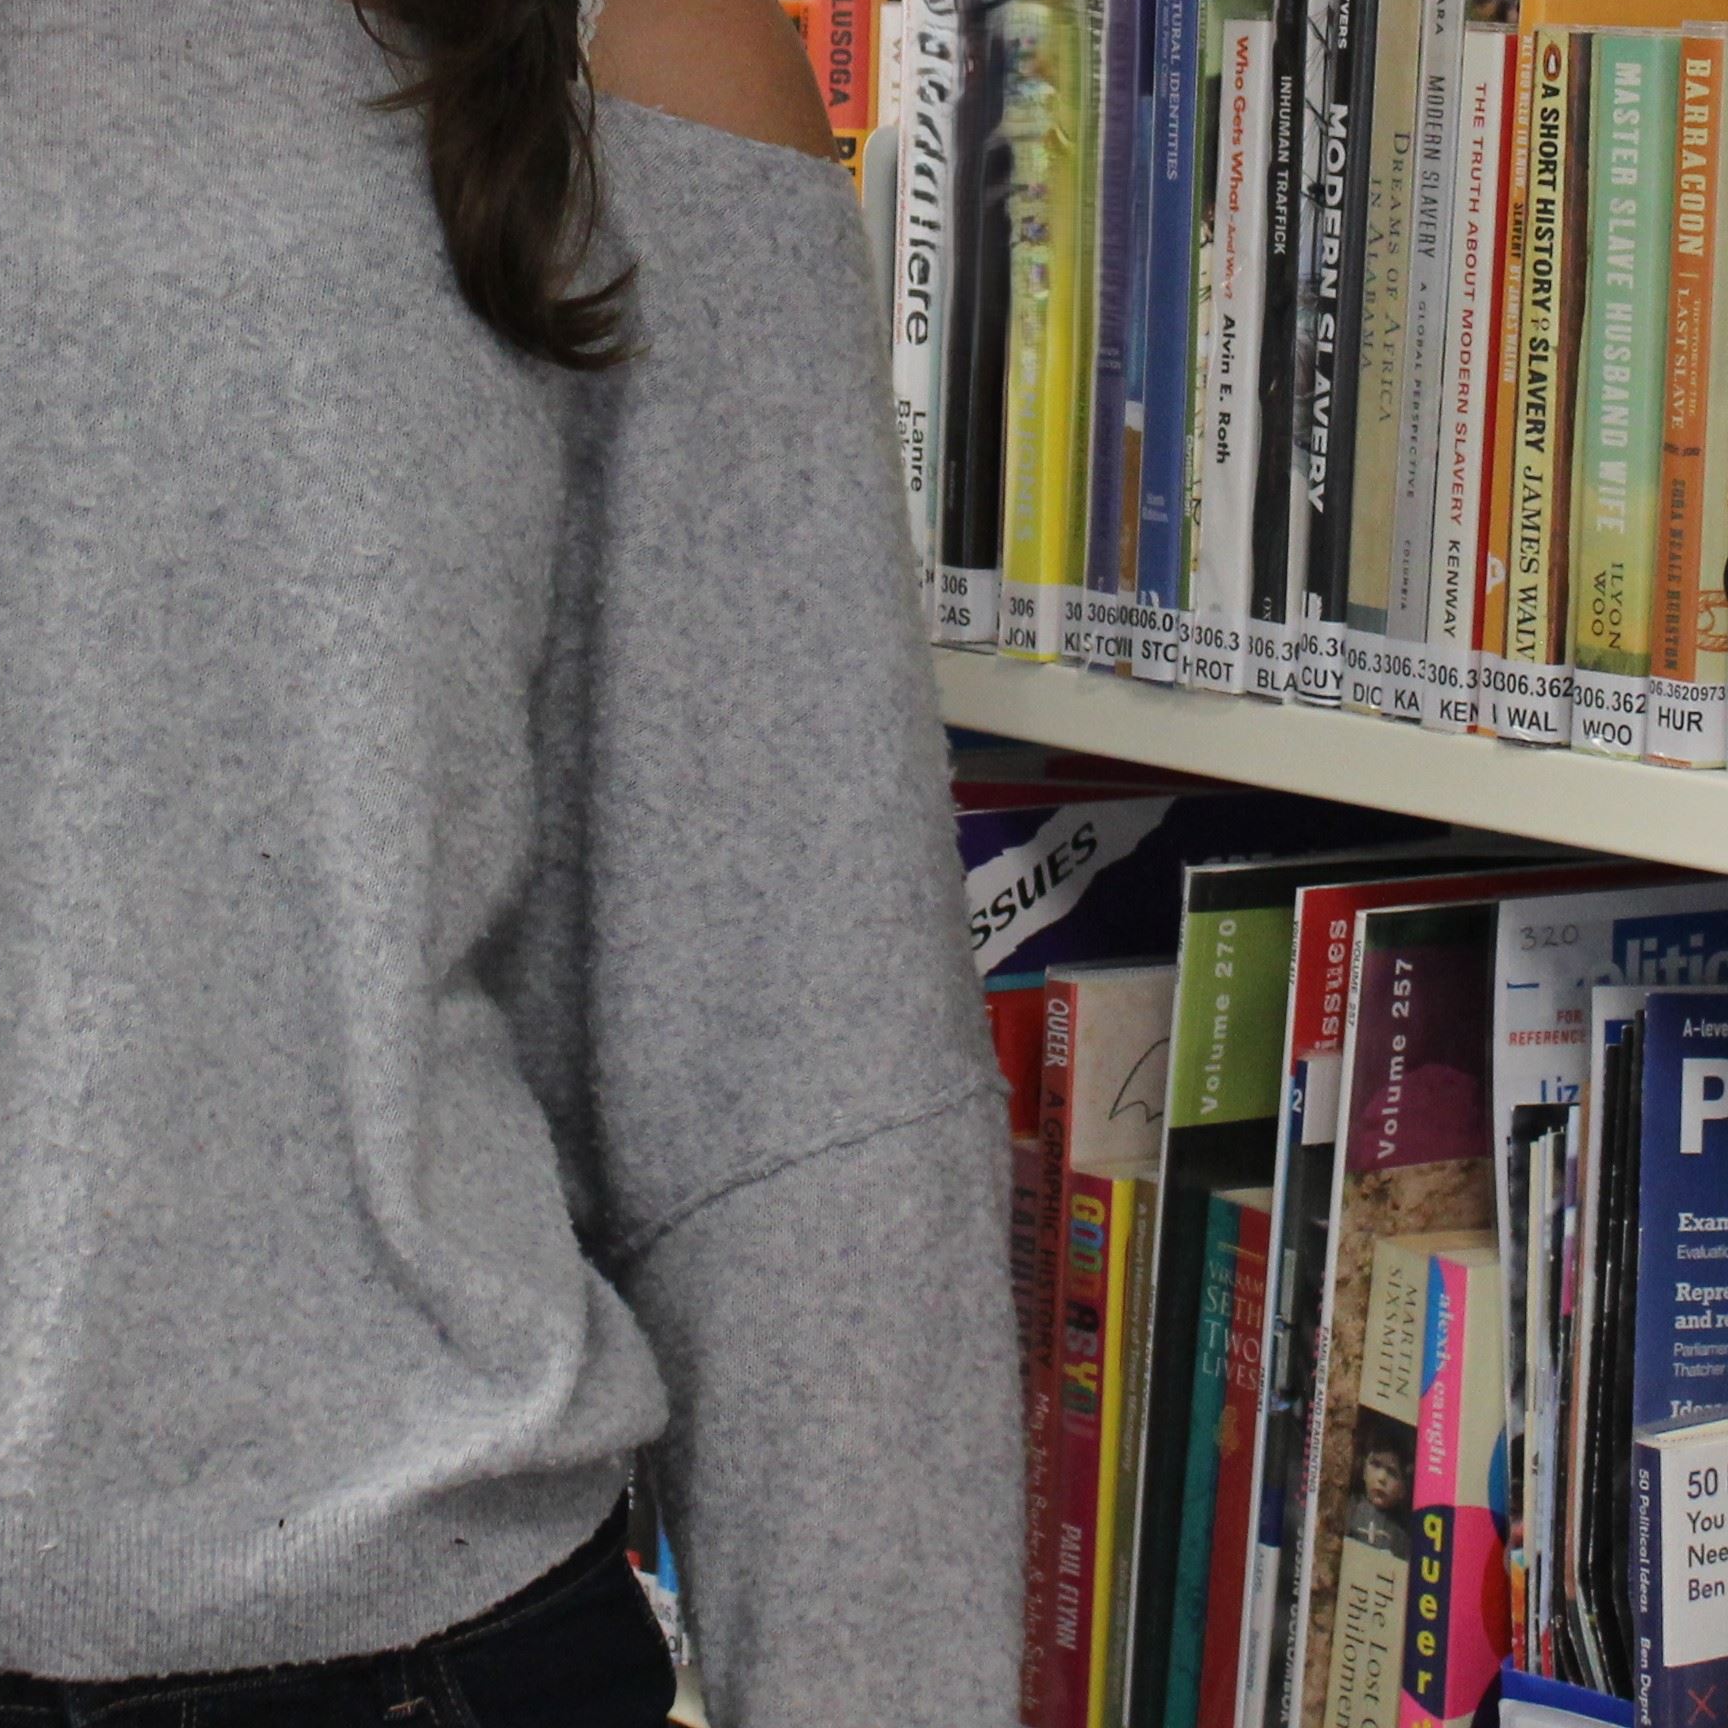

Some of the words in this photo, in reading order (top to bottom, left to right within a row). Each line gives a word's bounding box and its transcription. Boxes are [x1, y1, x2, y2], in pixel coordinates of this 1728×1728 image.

[1234, 37, 1248, 88] Who
[1541, 83, 1560, 99] A
[1165, 70, 1181, 181] IDENTITIES
[1231, 91, 1246, 140] Gets
[1276, 76, 1292, 163] INHUMAN
[1427, 76, 1445, 162] MODERN
[1472, 83, 1487, 128] THE
[1538, 106, 1560, 180] SHORT
[1611, 62, 1641, 185] MASTER
[1226, 145, 1245, 210] What
[1469, 139, 1485, 214] TRUTH
[1677, 57, 1712, 257] BARRACOON
[1273, 170, 1289, 256] TRAFFICK
[1318, 104, 1349, 299] MODERN
[1419, 170, 1441, 260] SLAVERY
[1464, 223, 1481, 299] ABOUT
[1532, 193, 1557, 313] HISTORY
[1606, 195, 1636, 290] SLAVE
[1221, 315, 1236, 372] Alvin
[1455, 309, 1476, 410] MODERN
[1600, 299, 1635, 448] HUSBAND
[1219, 384, 1232, 405] E.
[1306, 312, 1337, 514] SLAVERY
[1524, 335, 1549, 454] SLAVERY
[909, 410, 926, 493] Lanre
[1215, 418, 1232, 464] Roth
[1448, 420, 1468, 526] SLAVERY
[1518, 464, 1546, 575] JAMES
[1594, 461, 1630, 535] WIFE
[1442, 539, 1460, 639] KENWAY
[1591, 571, 1607, 637] WOO
[1507, 706, 1558, 733] WAL
[1581, 719, 1633, 746] WOO
[1657, 705, 1703, 733] HUR
[1215, 919, 1238, 976] 270
[1520, 924, 1580, 950] 320
[1391, 958, 1415, 1018] 257
[1200, 995, 1232, 1115] Volume
[1377, 1032, 1408, 1159] Volume
[1675, 1311, 1711, 1328] and
[1686, 1509, 1724, 1535] You
[1687, 1468, 1719, 1501] 50
[1687, 1578, 1726, 1602] Ben
